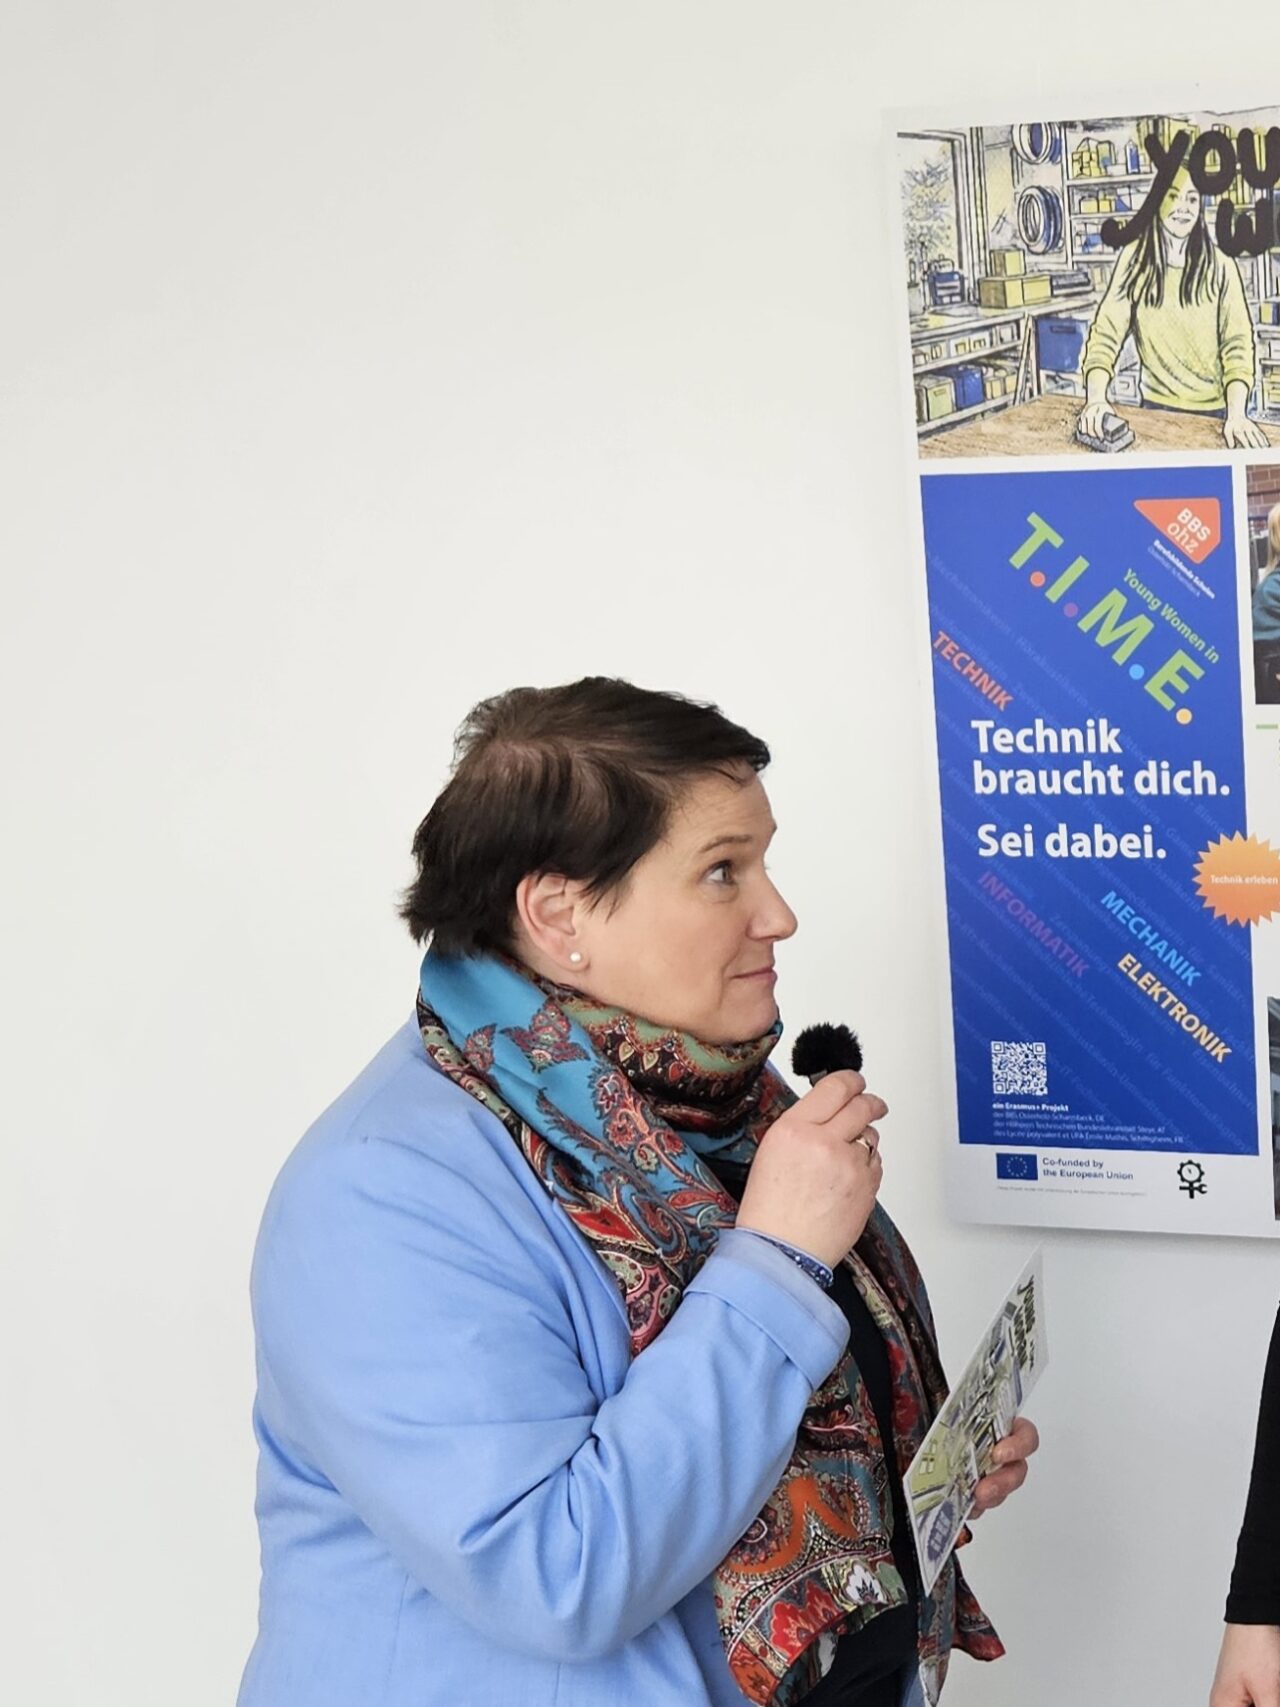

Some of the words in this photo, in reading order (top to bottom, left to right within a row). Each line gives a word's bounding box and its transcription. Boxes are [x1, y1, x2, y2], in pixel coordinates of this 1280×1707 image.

[1166, 522, 1200, 555] ohz
[1176, 508, 1212, 542] BBS
[1009, 512, 1205, 725] T.I.M.E.
[1123, 567, 1161, 612] Young
[1159, 603, 1206, 651] Women
[1204, 645, 1220, 665] in
[932, 630, 1014, 712] TECHNIK
[971, 717, 1123, 753] Technik
[972, 759, 1124, 796] braucht
[1134, 759, 1231, 796] dich.
[977, 823, 1034, 858] Sei
[1045, 823, 1167, 859] dabei.
[1210, 873, 1243, 886] Technik
[1245, 874, 1278, 886] erleben
[976, 870, 1089, 979] INFORMATIK
[1100, 890, 1202, 987] MECHANIK
[1116, 953, 1233, 1063] ELEKTRONIK
[1041, 1104, 1069, 1113] Projekt
[1042, 1157, 1090, 1167] Co-funded
[1093, 1159, 1104, 1169] by
[1043, 1169, 1057, 1177] the
[1060, 1170, 1104, 1180] European
[1107, 1172, 1134, 1181] Union
